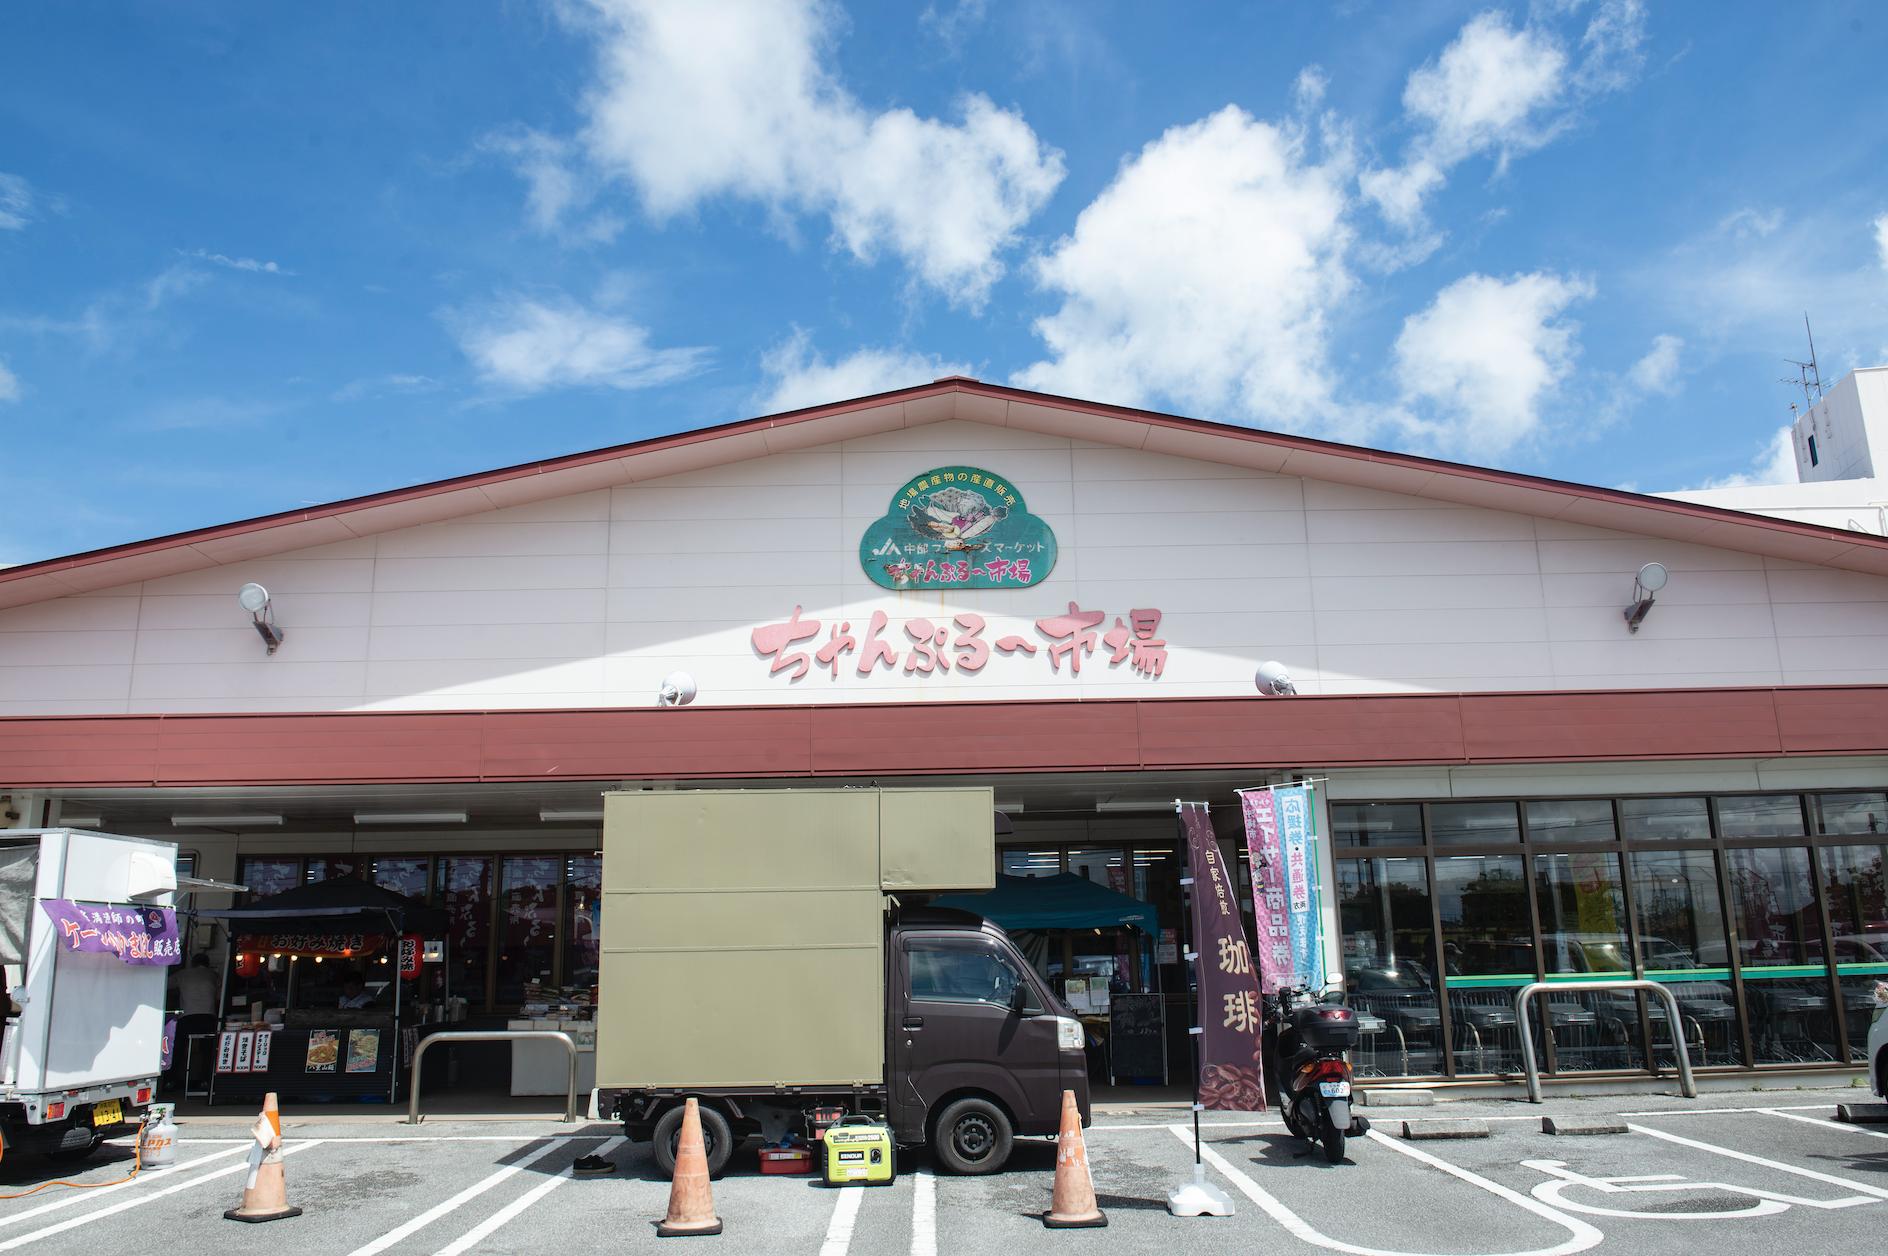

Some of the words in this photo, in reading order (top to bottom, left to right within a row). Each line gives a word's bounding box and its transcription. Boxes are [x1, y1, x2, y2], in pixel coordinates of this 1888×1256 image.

[899, 472, 1016, 510] 地場農産物の産直販売
[904, 543, 928, 554] 中部
[1218, 935, 1258, 1034] 珈琲
